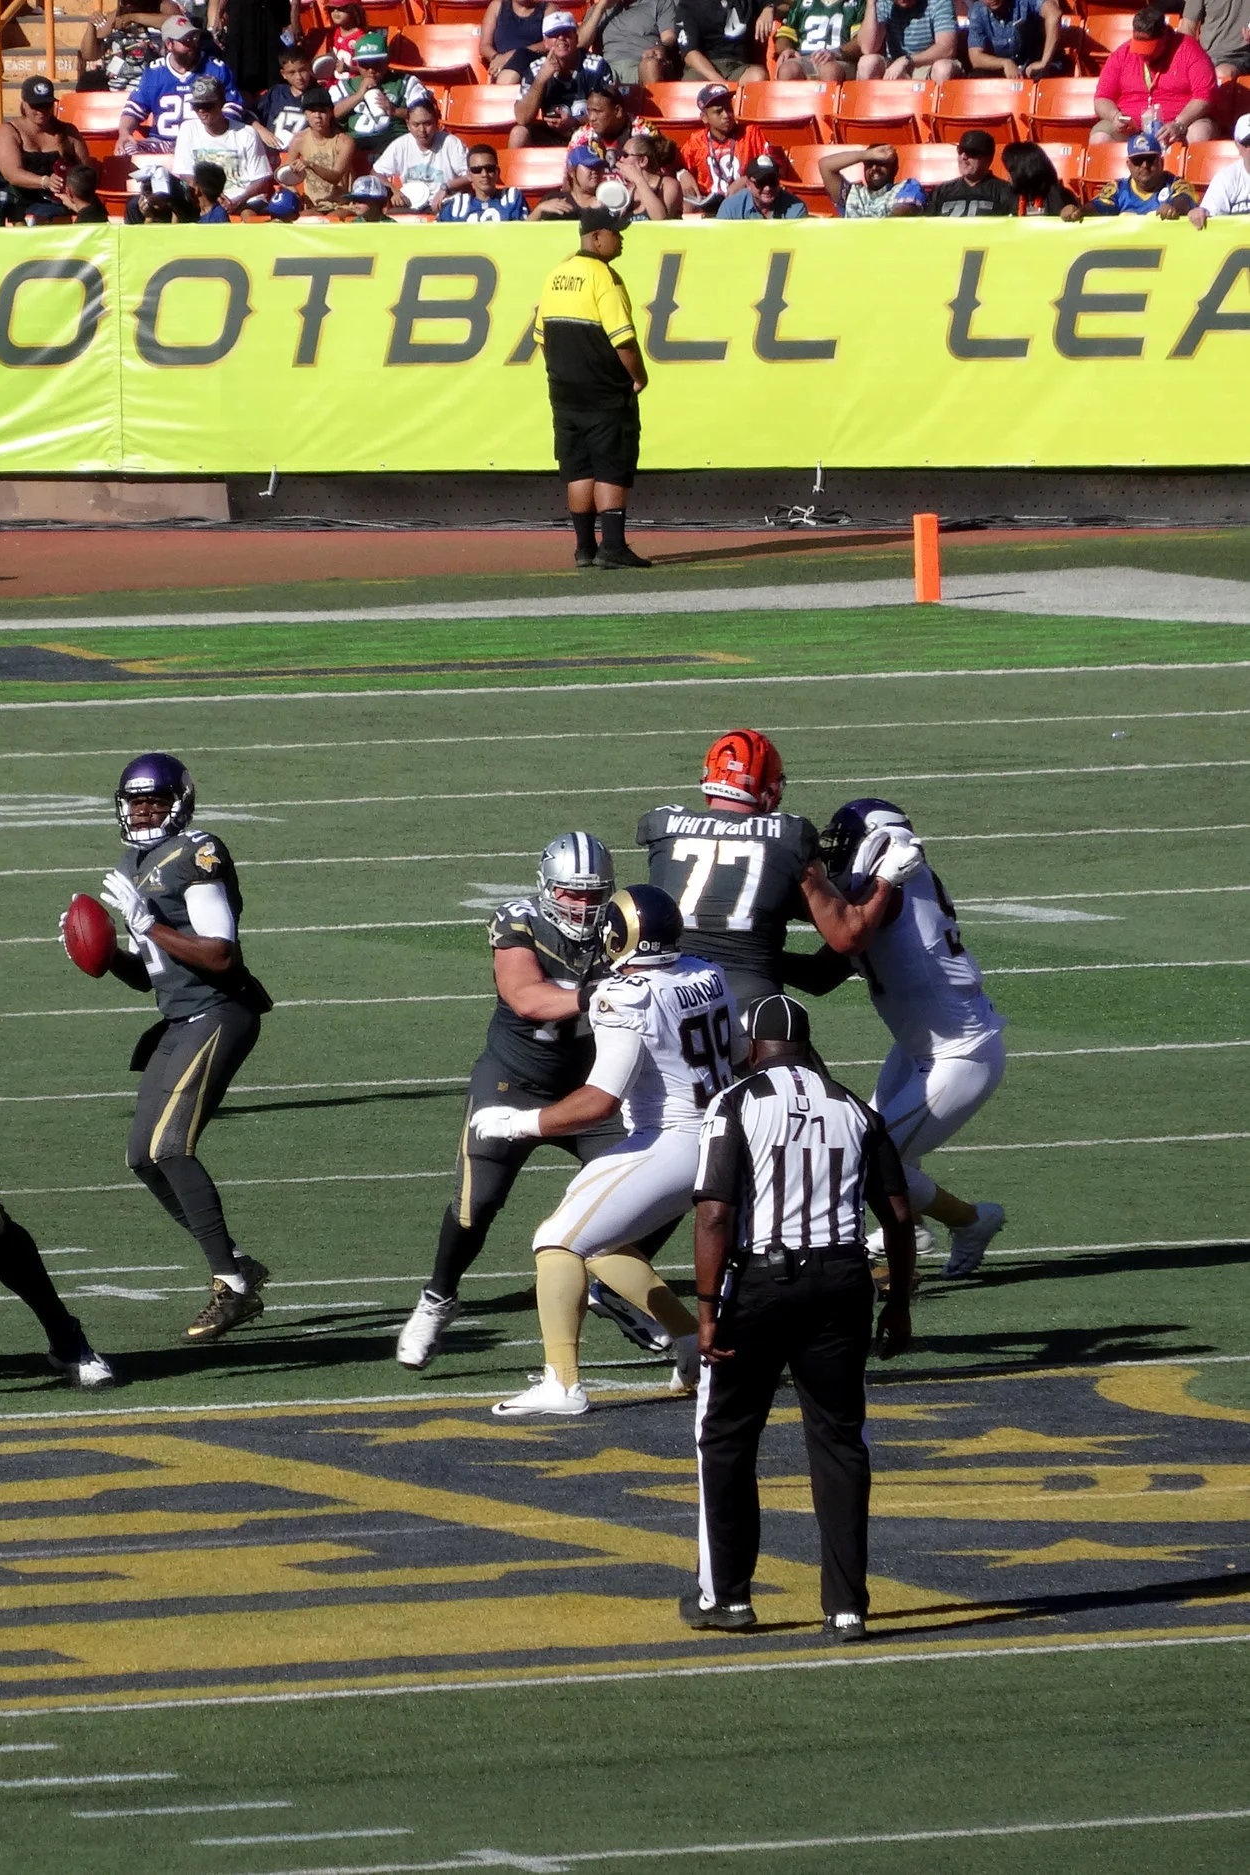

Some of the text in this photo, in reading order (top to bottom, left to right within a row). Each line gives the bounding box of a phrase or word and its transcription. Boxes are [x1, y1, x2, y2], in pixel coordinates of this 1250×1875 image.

[801, 14, 845, 52] 21
[551, 275, 587, 293] SECURITY
[946, 243, 1250, 364] LEA
[665, 814, 781, 839] WHITWORTH
[671, 837, 767, 931] 77
[674, 975, 724, 1010] DONALD
[678, 1007, 733, 1110] 99
[795, 1096, 810, 1112] U
[787, 1112, 826, 1145] 71
